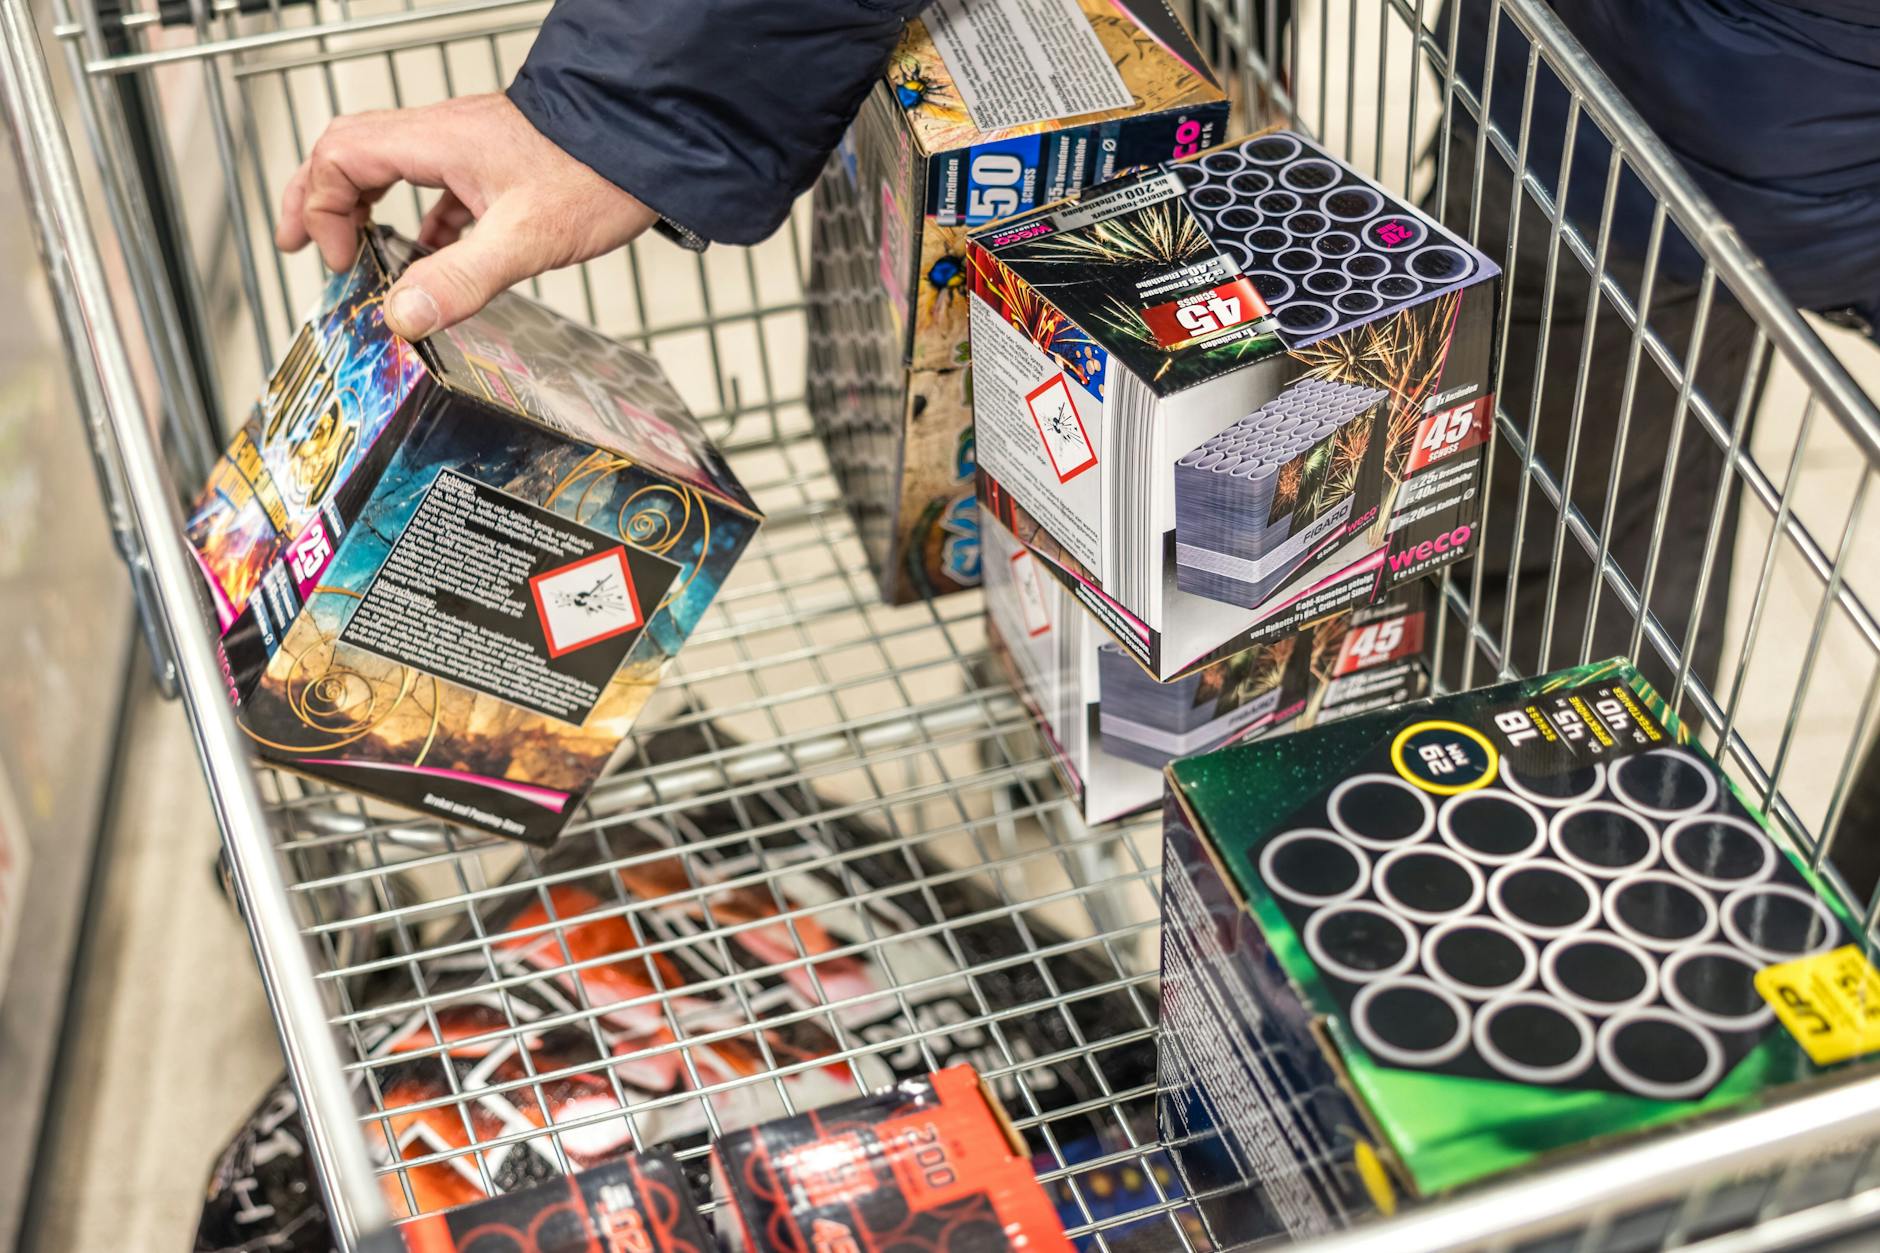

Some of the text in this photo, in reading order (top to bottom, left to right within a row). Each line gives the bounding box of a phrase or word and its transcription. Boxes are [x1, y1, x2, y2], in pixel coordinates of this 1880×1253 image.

[946, 159, 959, 208] Anzünden
[969, 154, 1022, 217] 50
[1021, 168, 1036, 203] SCHUSS
[1057, 194, 1118, 219] Effektladung
[1088, 186, 1178, 221] Batterie-Feuerwerk
[992, 222, 1054, 249] weco
[1132, 269, 1182, 291] Effekthöhe
[1135, 277, 1190, 301] Brenndauer
[1175, 296, 1243, 336] 45
[1177, 290, 1218, 308] SCHUSS
[1196, 330, 1245, 351] Anzünden
[1421, 401, 1475, 454] 45
[1428, 442, 1460, 461] SCHUSS
[1304, 505, 1348, 543] FIGARO
[1347, 506, 1376, 532] weco
[297, 525, 330, 578] 25
[1387, 521, 1471, 572] weco
[1393, 544, 1464, 581] feuerwerk
[1250, 628, 1264, 639] von
[1318, 600, 1336, 612] Grün
[1337, 594, 1350, 606] und
[1351, 584, 1373, 598] Silber
[1351, 618, 1406, 657] 45
[1494, 709, 1539, 747] 18
[1525, 705, 1556, 742] SCHUSS
[1553, 707, 1585, 741] 45
[1596, 701, 1628, 730] 40
[1612, 686, 1661, 741] EFFEKTDAUER
[1418, 743, 1455, 775] 29
[1444, 743, 1470, 767] MM
[904, 1122, 955, 1188] 200
